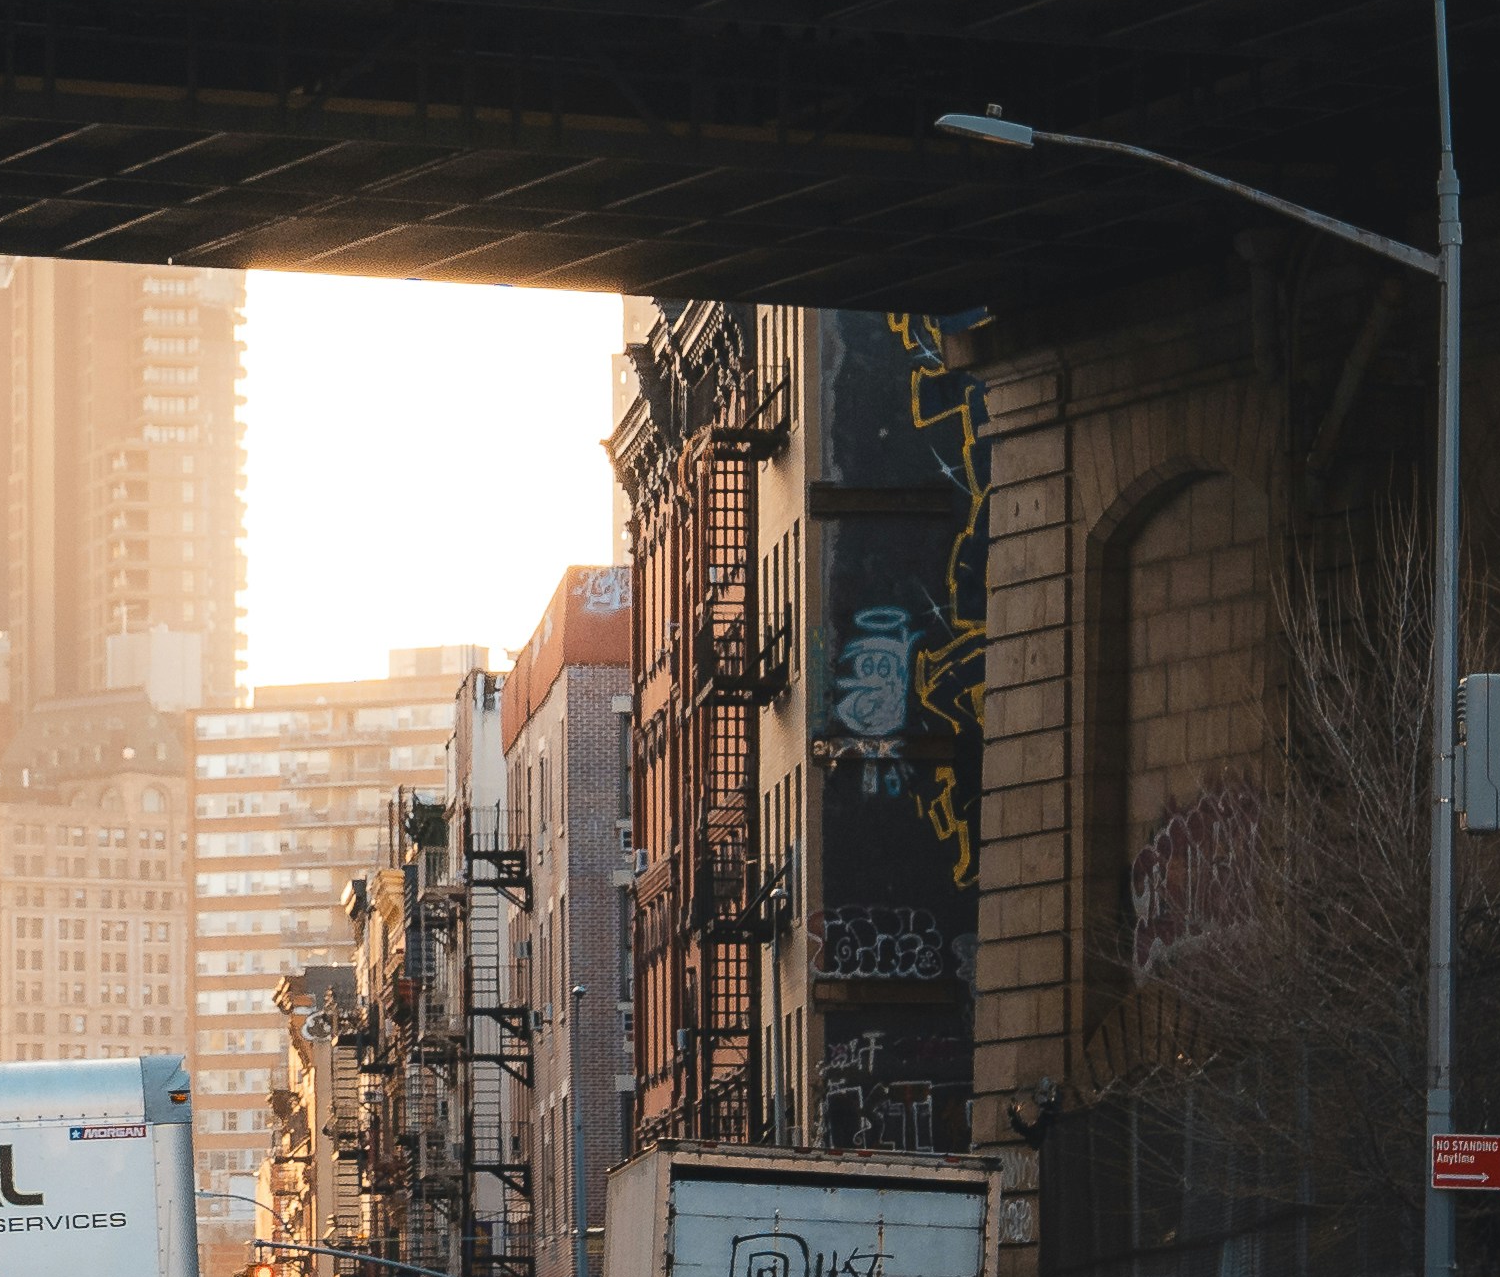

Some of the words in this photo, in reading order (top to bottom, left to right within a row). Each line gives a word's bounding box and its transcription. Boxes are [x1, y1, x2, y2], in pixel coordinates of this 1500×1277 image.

[82, 1127, 146, 1139] MORGAN
[1436, 1140, 1449, 1151] NO
[1452, 1140, 1499, 1152] STANDING
[1436, 1153, 1475, 1165] Anytime
